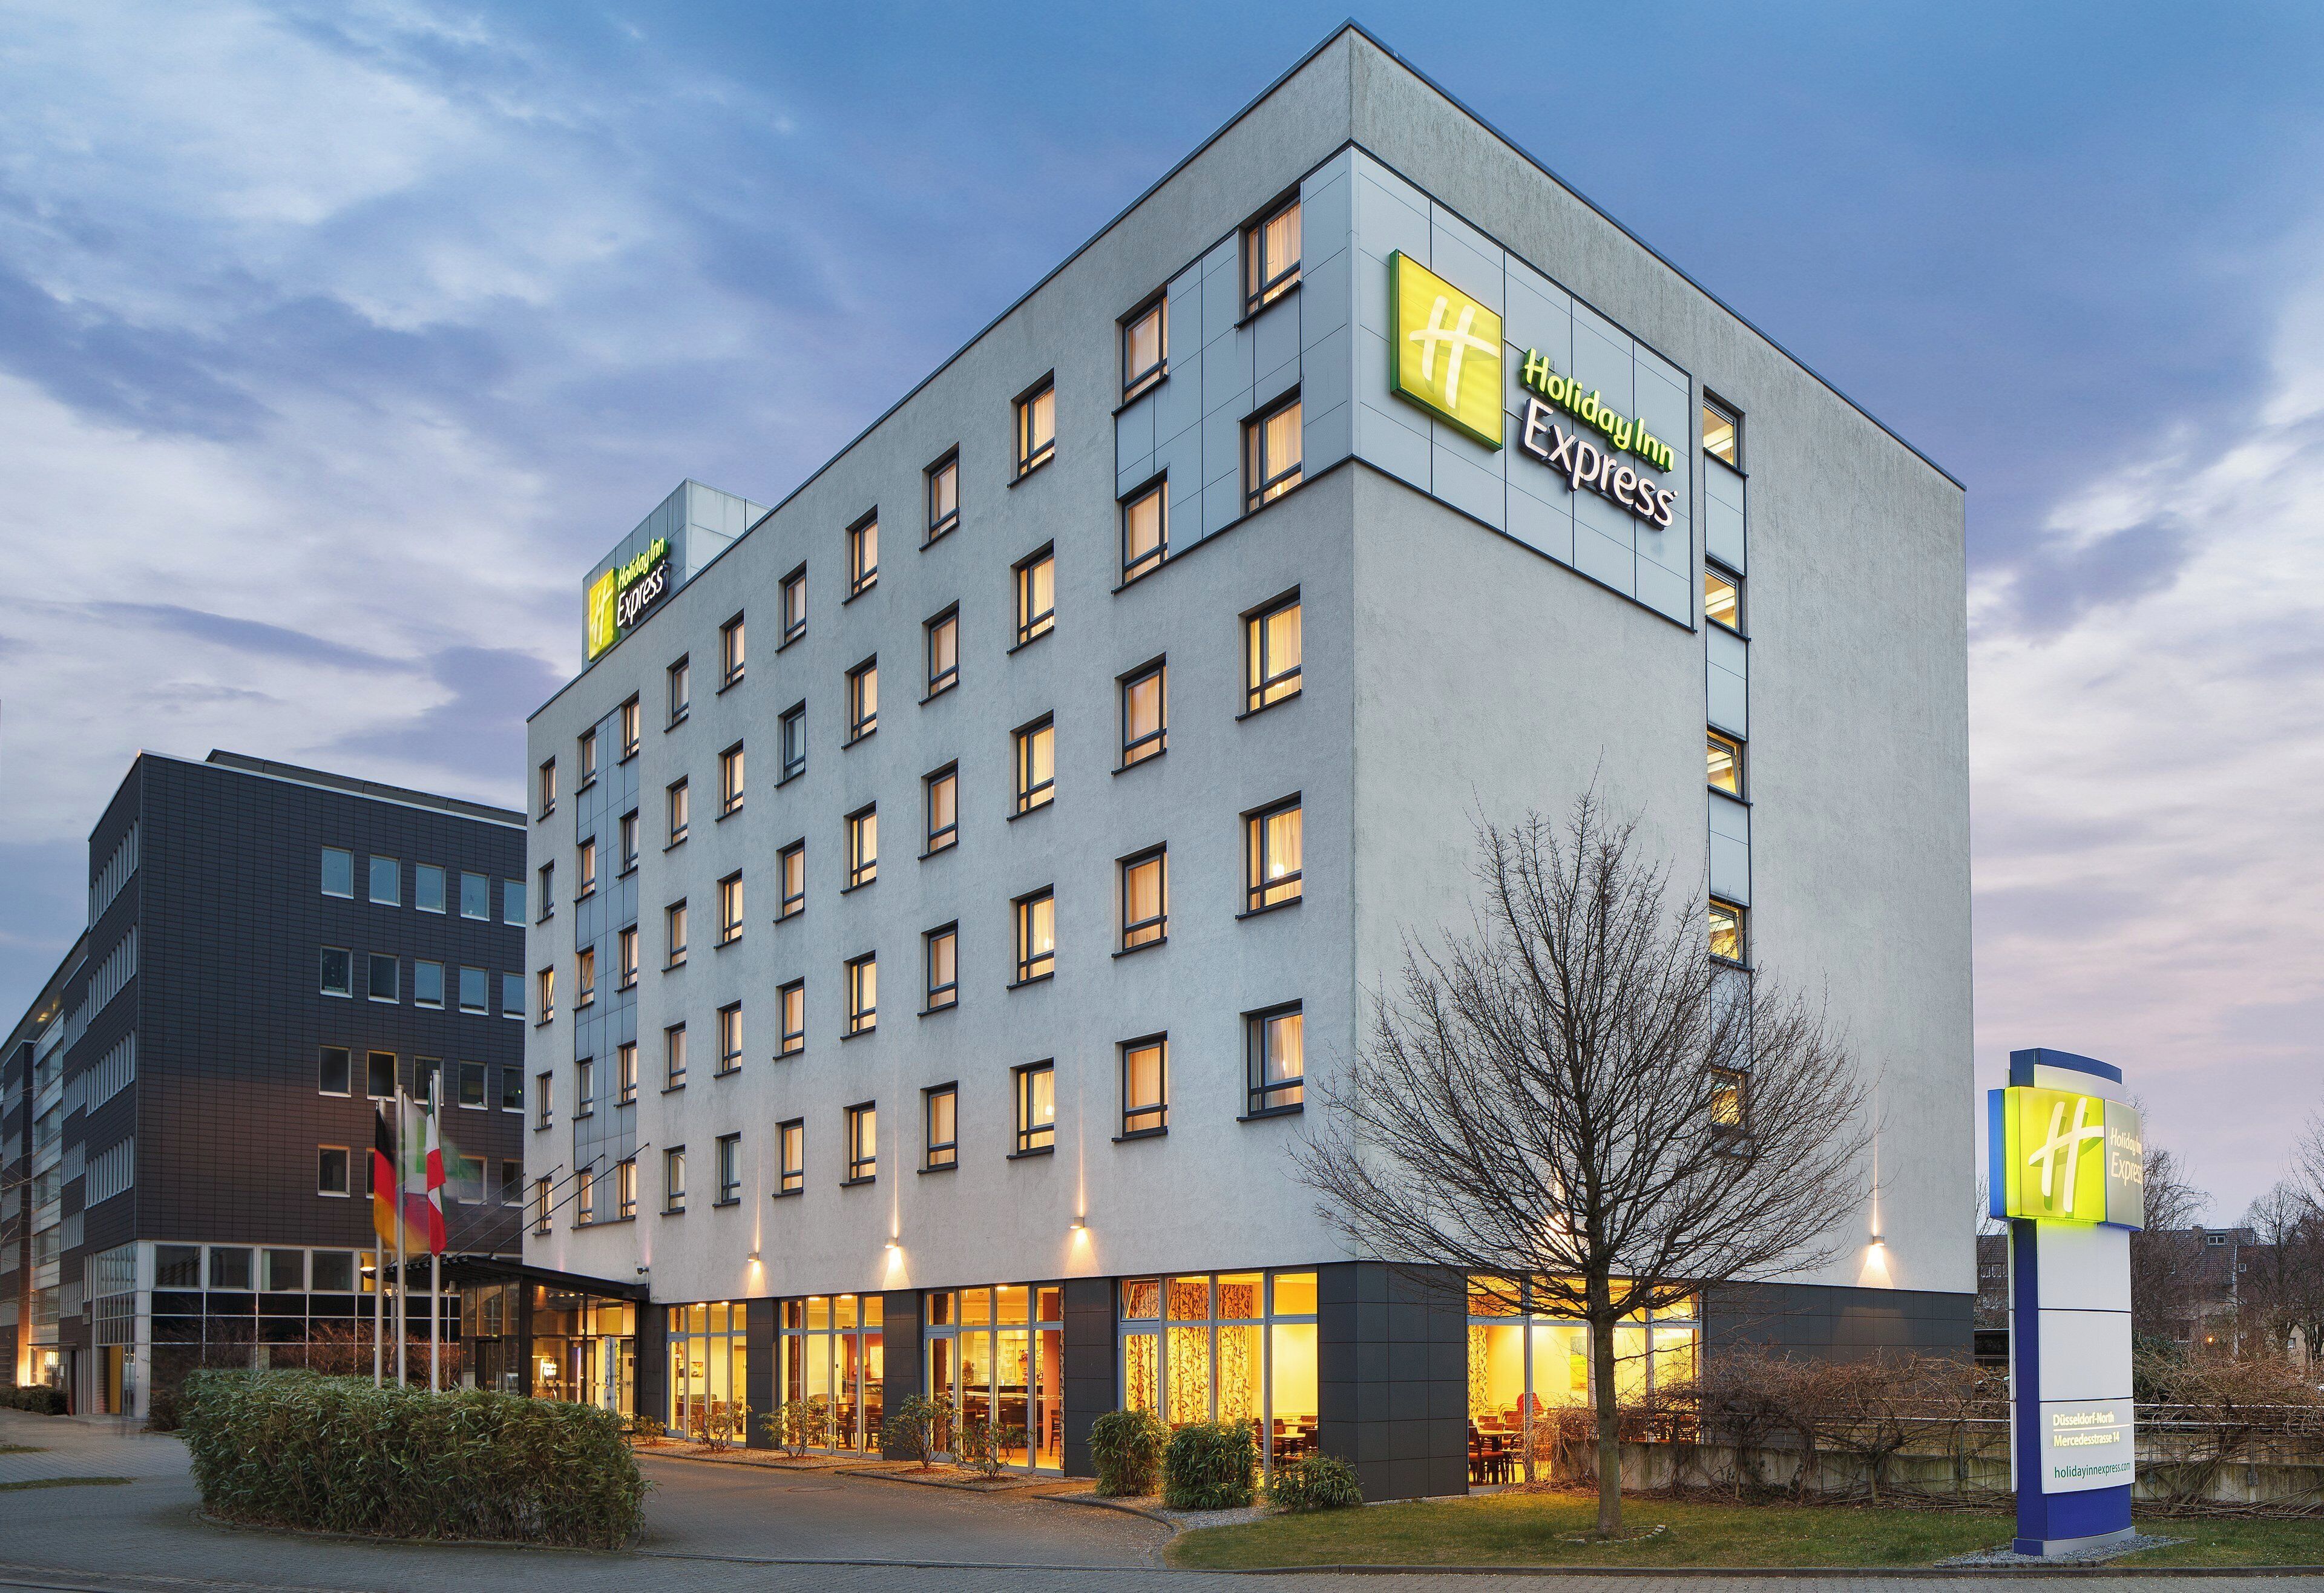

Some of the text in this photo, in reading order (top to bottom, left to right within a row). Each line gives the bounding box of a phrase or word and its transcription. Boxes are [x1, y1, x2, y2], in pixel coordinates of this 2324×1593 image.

[1523, 348, 1674, 472] Holiday Inn
[1521, 397, 1674, 527] Express
[618, 537, 665, 592] Holiday Inn
[617, 565, 664, 627] Express
[2110, 1128, 2136, 1156] Holiday
[2111, 1151, 2142, 1186] Express
[2053, 1411, 2115, 1426] Düsseldorf-North
[2053, 1431, 2119, 1447] Mercedesstrasse 14
[2055, 1462, 2130, 1479] holidayinnexpress.com
